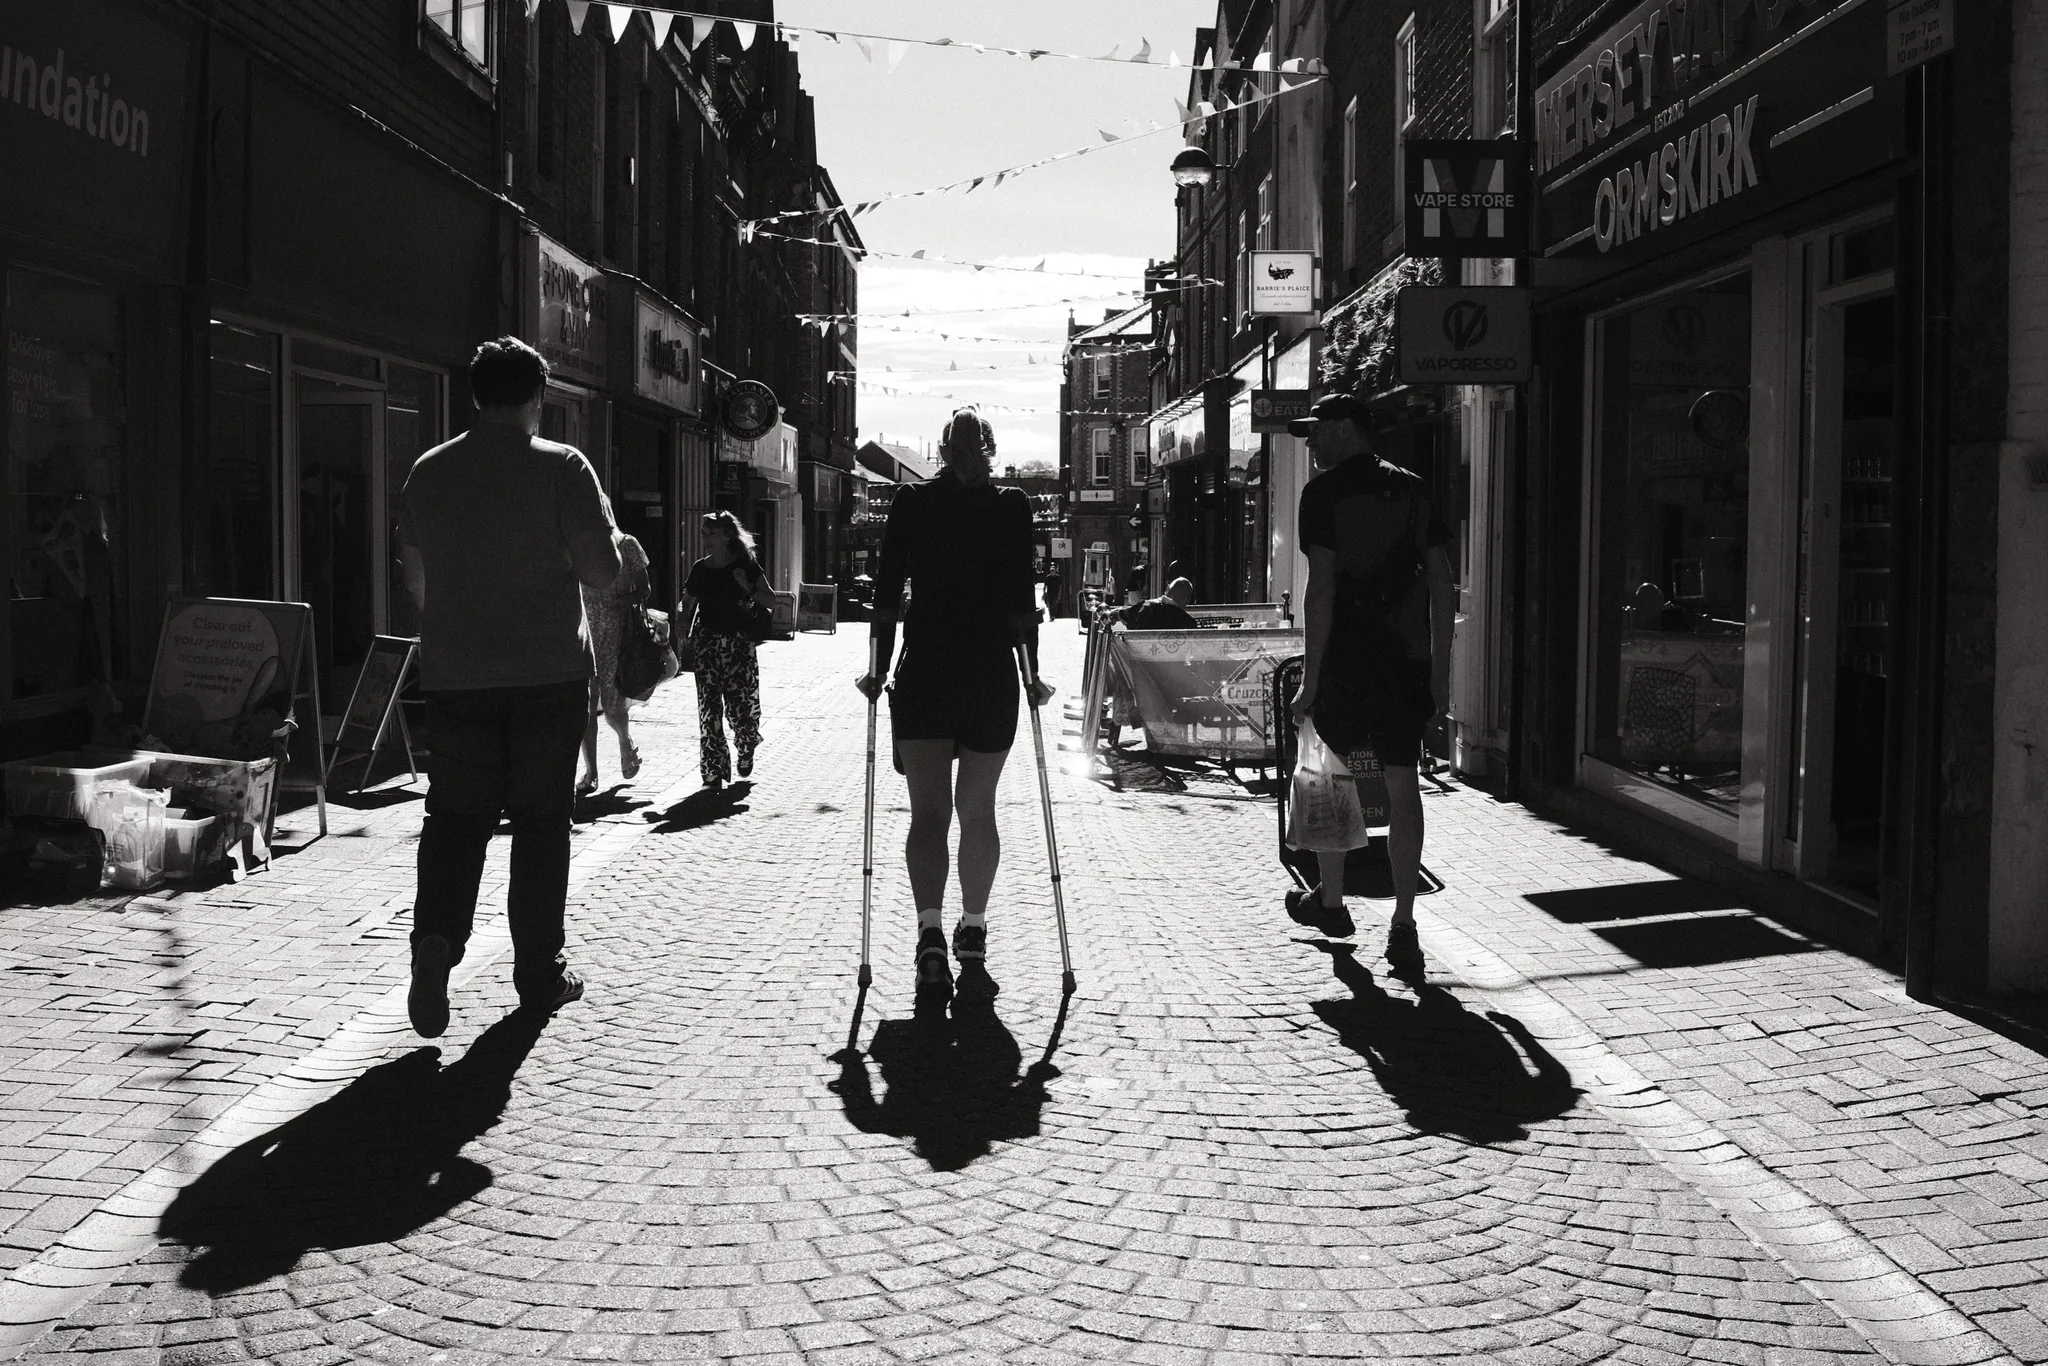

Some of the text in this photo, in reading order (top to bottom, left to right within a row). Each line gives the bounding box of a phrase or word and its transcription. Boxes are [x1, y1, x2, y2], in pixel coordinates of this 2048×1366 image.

[1537, 9, 1660, 177] MERSEY
[1594, 93, 1759, 254] ORMSKIRK
[1414, 193, 1515, 208] VAPE STORE
[1415, 357, 1518, 372] VAPORESSO
[1274, 406, 1310, 417] EATS
[192, 616, 253, 633] Clear out
[174, 634, 266, 652] your preloved
[177, 653, 254, 669] accessories
[218, 671, 230, 681] the
[1347, 750, 1373, 759] TION
[1359, 806, 1384, 818] PEN
